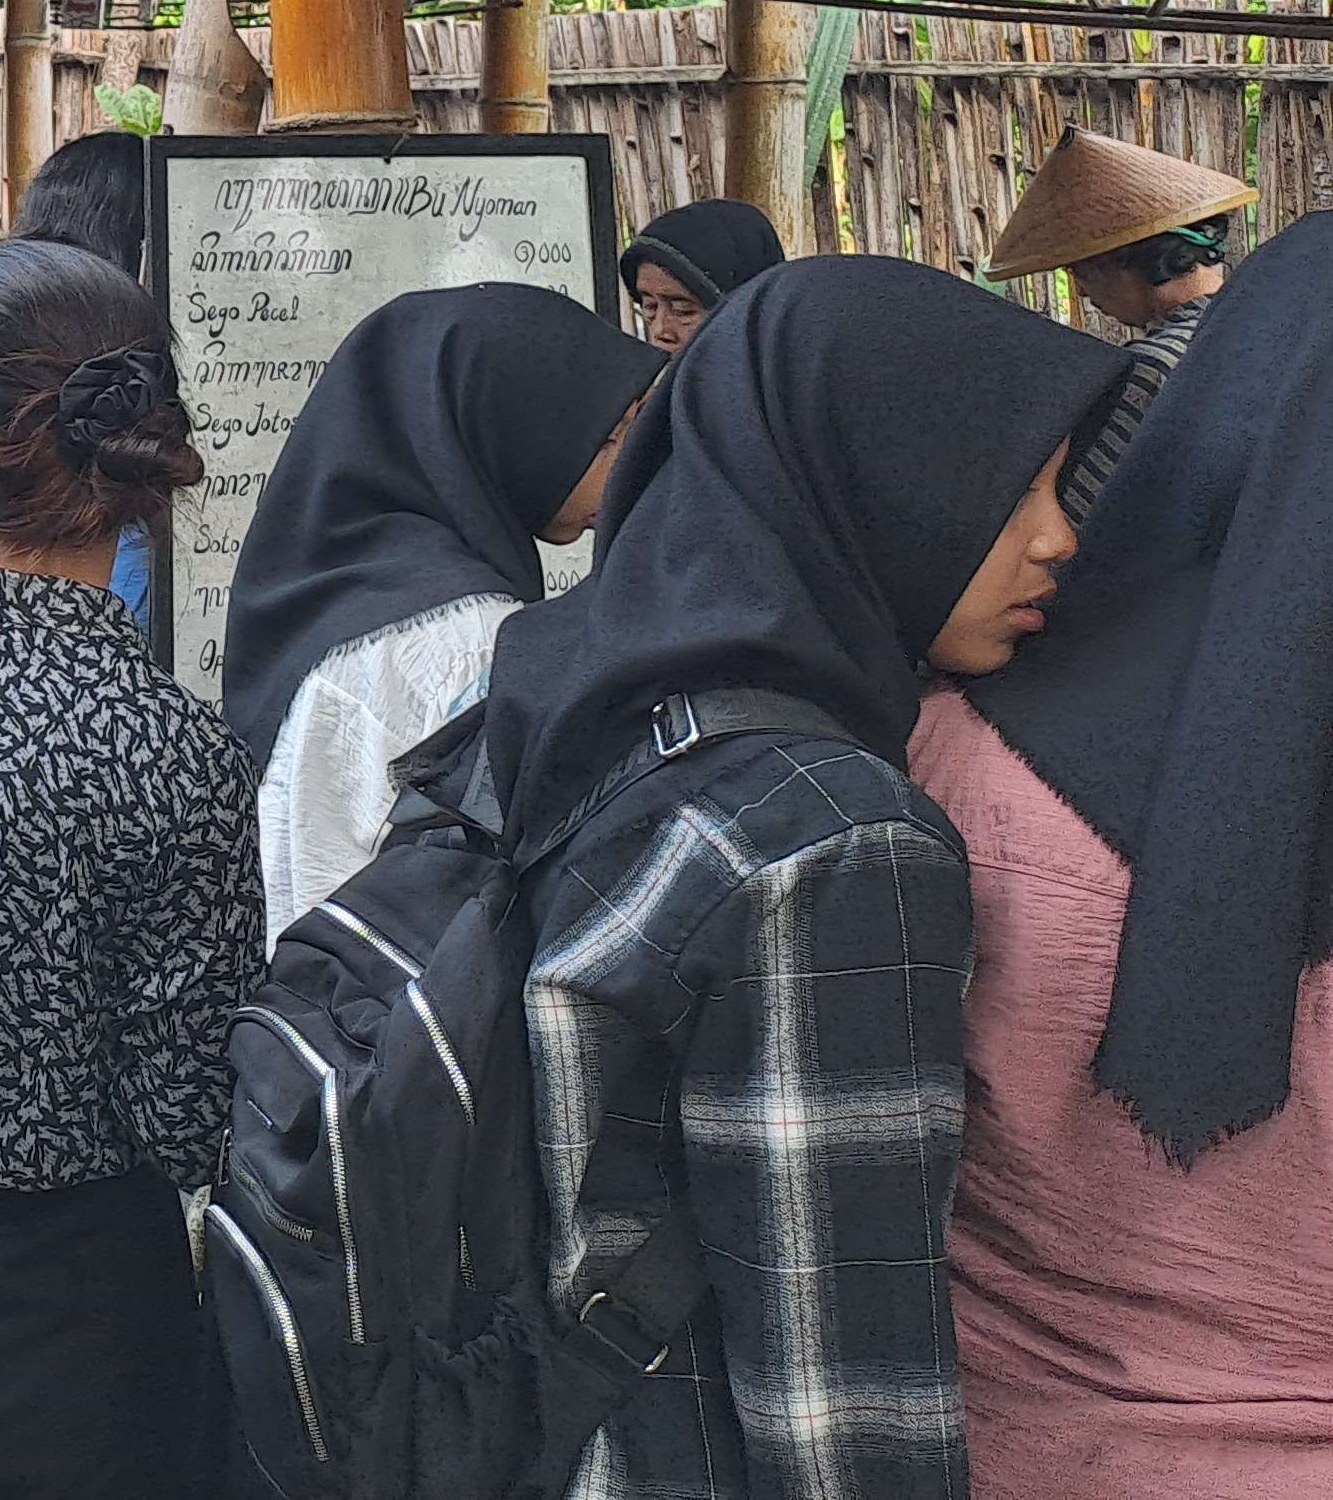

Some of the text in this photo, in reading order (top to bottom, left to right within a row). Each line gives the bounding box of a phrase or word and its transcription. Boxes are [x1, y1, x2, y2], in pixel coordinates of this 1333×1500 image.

[405, 176, 445, 220] Bu
[449, 176, 537, 242] Nyoman
[188, 291, 299, 338] Sego Pecel
[193, 402, 242, 449] Sego
[194, 524, 240, 554] Soto
